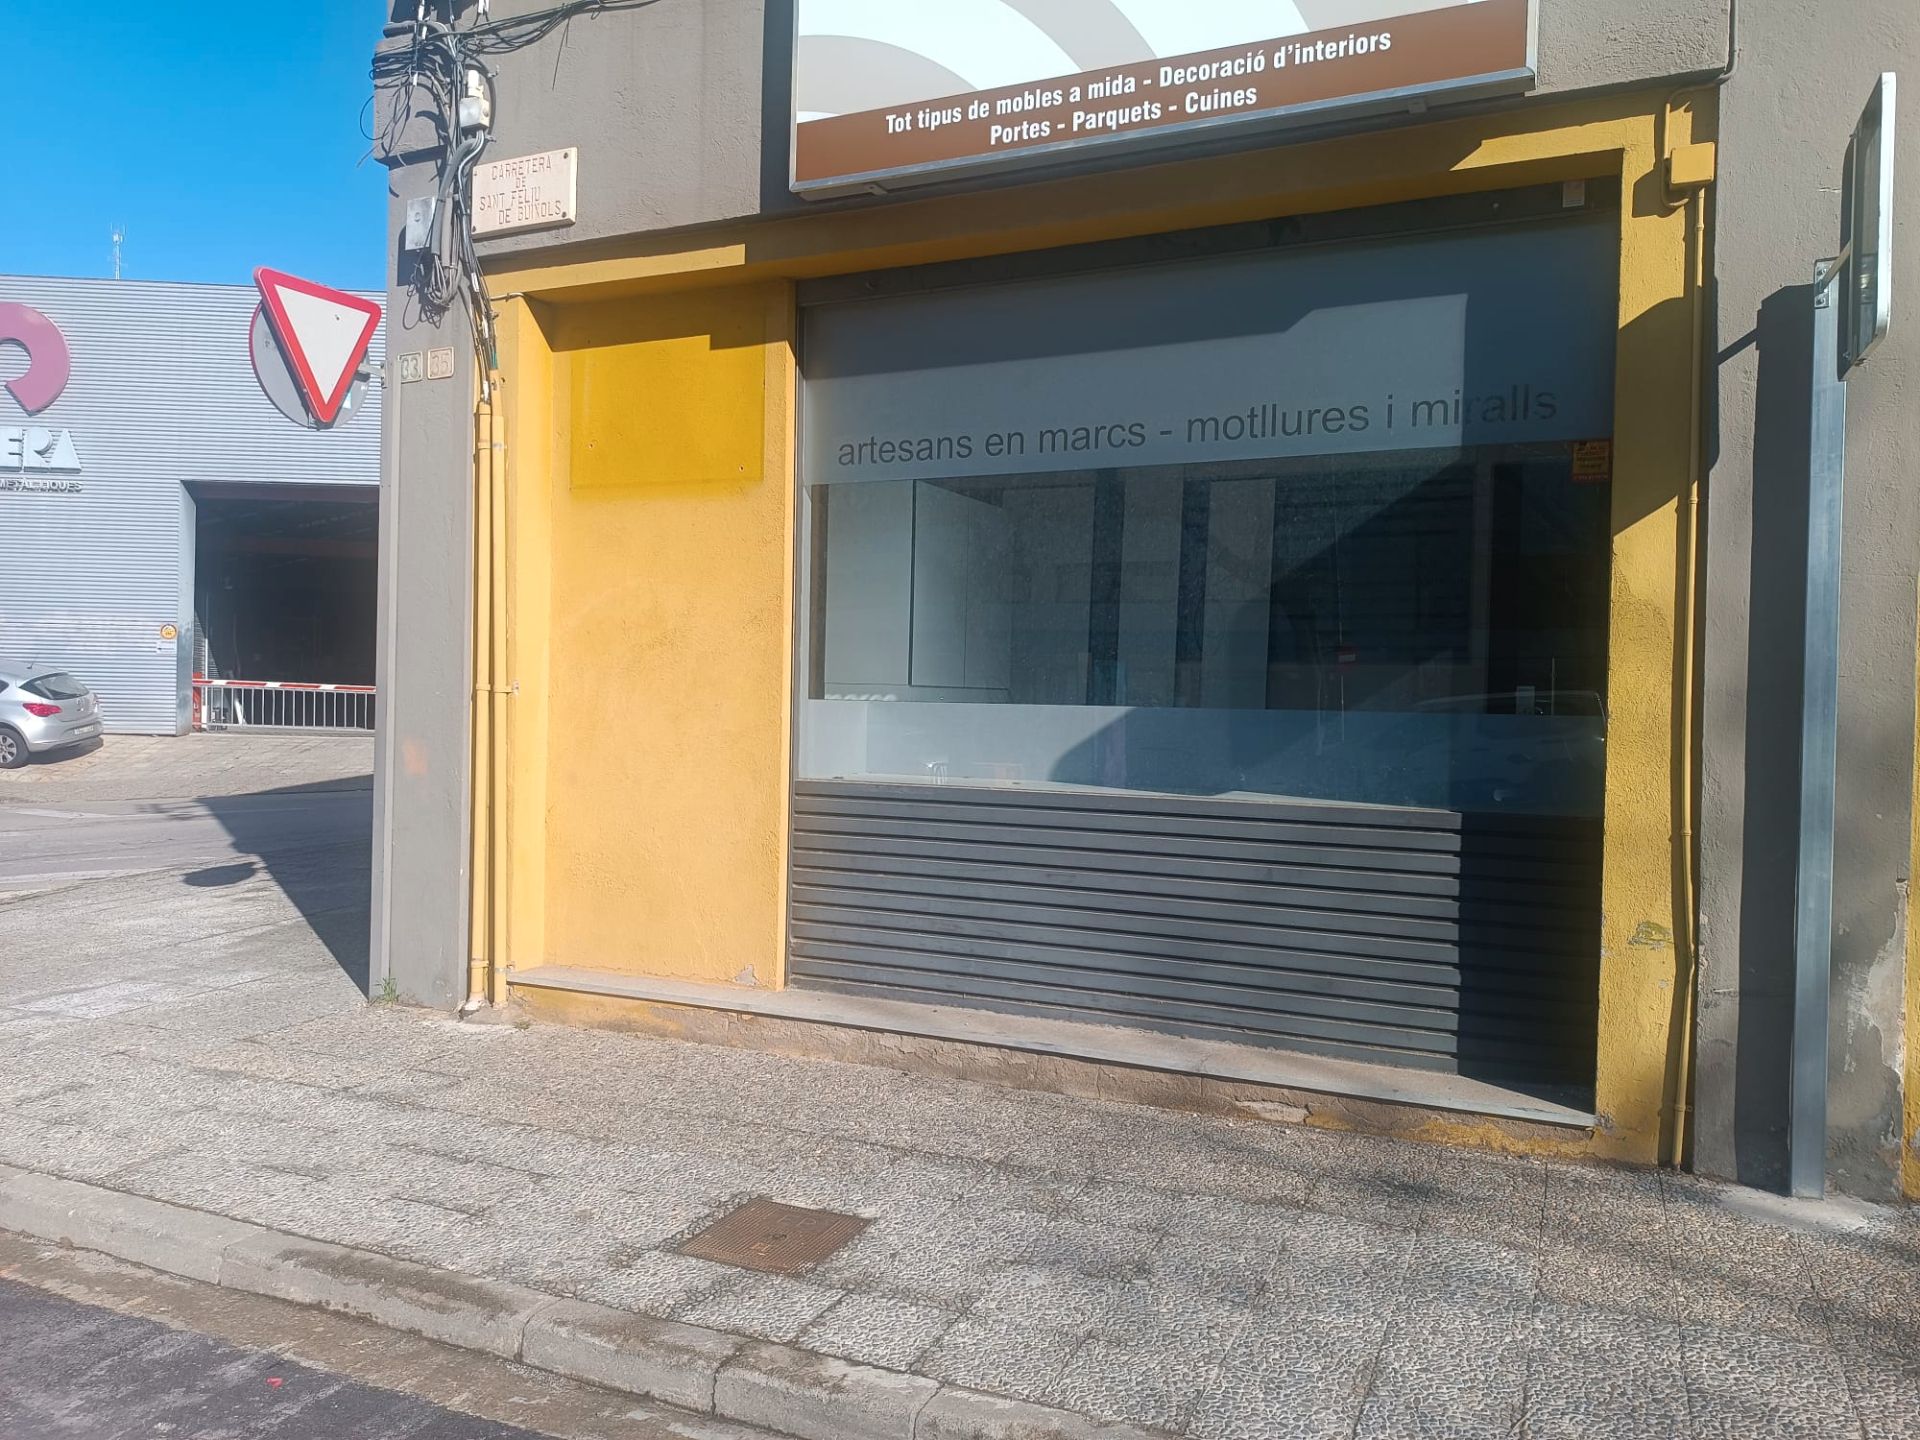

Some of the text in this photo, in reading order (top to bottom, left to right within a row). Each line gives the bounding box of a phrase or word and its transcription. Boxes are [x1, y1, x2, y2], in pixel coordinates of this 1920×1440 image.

[886, 112, 912, 134] Tot
[917, 107, 962, 130] tipus
[968, 100, 990, 120] de
[996, 88, 1063, 116] mobles
[1069, 86, 1081, 102] a
[1088, 74, 1136, 100] mida
[1159, 50, 1265, 87] Decoració
[1273, 32, 1391, 69] d'interiors
[990, 119, 1051, 145] Portes
[1072, 100, 1161, 131] Parquets
[1185, 87, 1257, 113] Cuines
[492, 155, 551, 180] CARRETERA
[516, 176, 526, 188] DE
[480, 186, 541, 211] SANT FELIU
[499, 208, 511, 225] DE
[838, 433, 973, 466] artesans
[985, 431, 1024, 457] en
[1039, 421, 1146, 454] marcs
[1187, 403, 1369, 443] motllures
[1387, 394, 1393, 428] i
[1411, 384, 1558, 427] miralls
